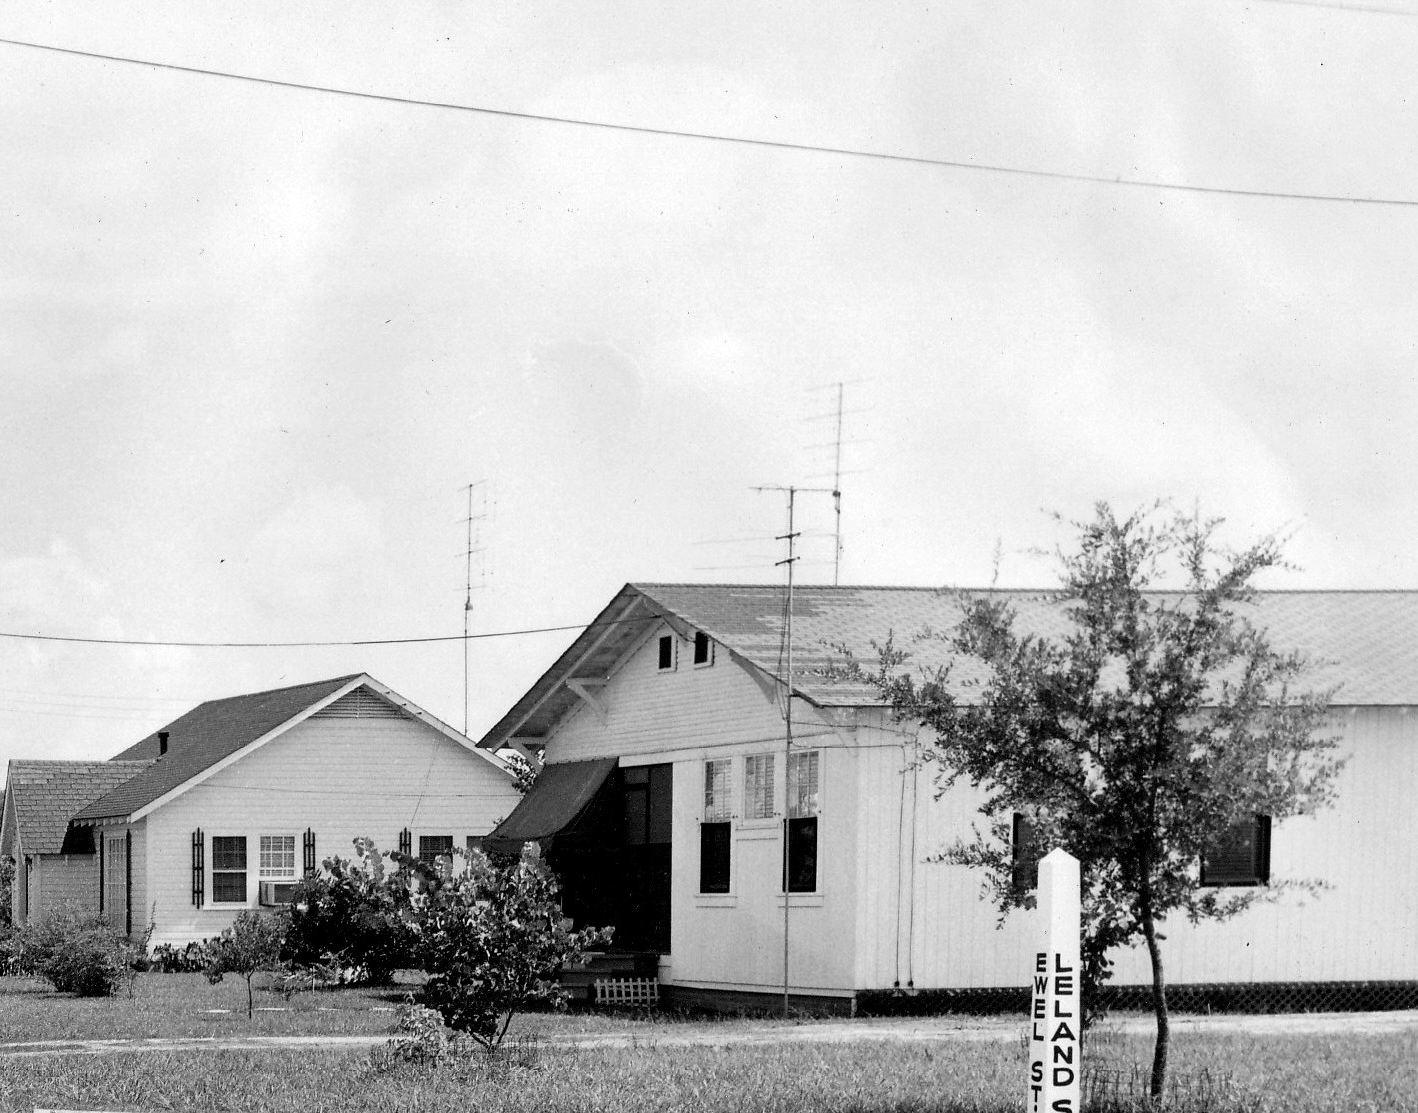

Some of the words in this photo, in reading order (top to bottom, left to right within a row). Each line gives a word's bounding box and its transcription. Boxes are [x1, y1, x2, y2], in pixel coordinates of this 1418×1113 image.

[1033, 952, 1048, 1041] EWEL
[1050, 953, 1076, 1087] LELAND
[1031, 1060, 1043, 1113] ST.
